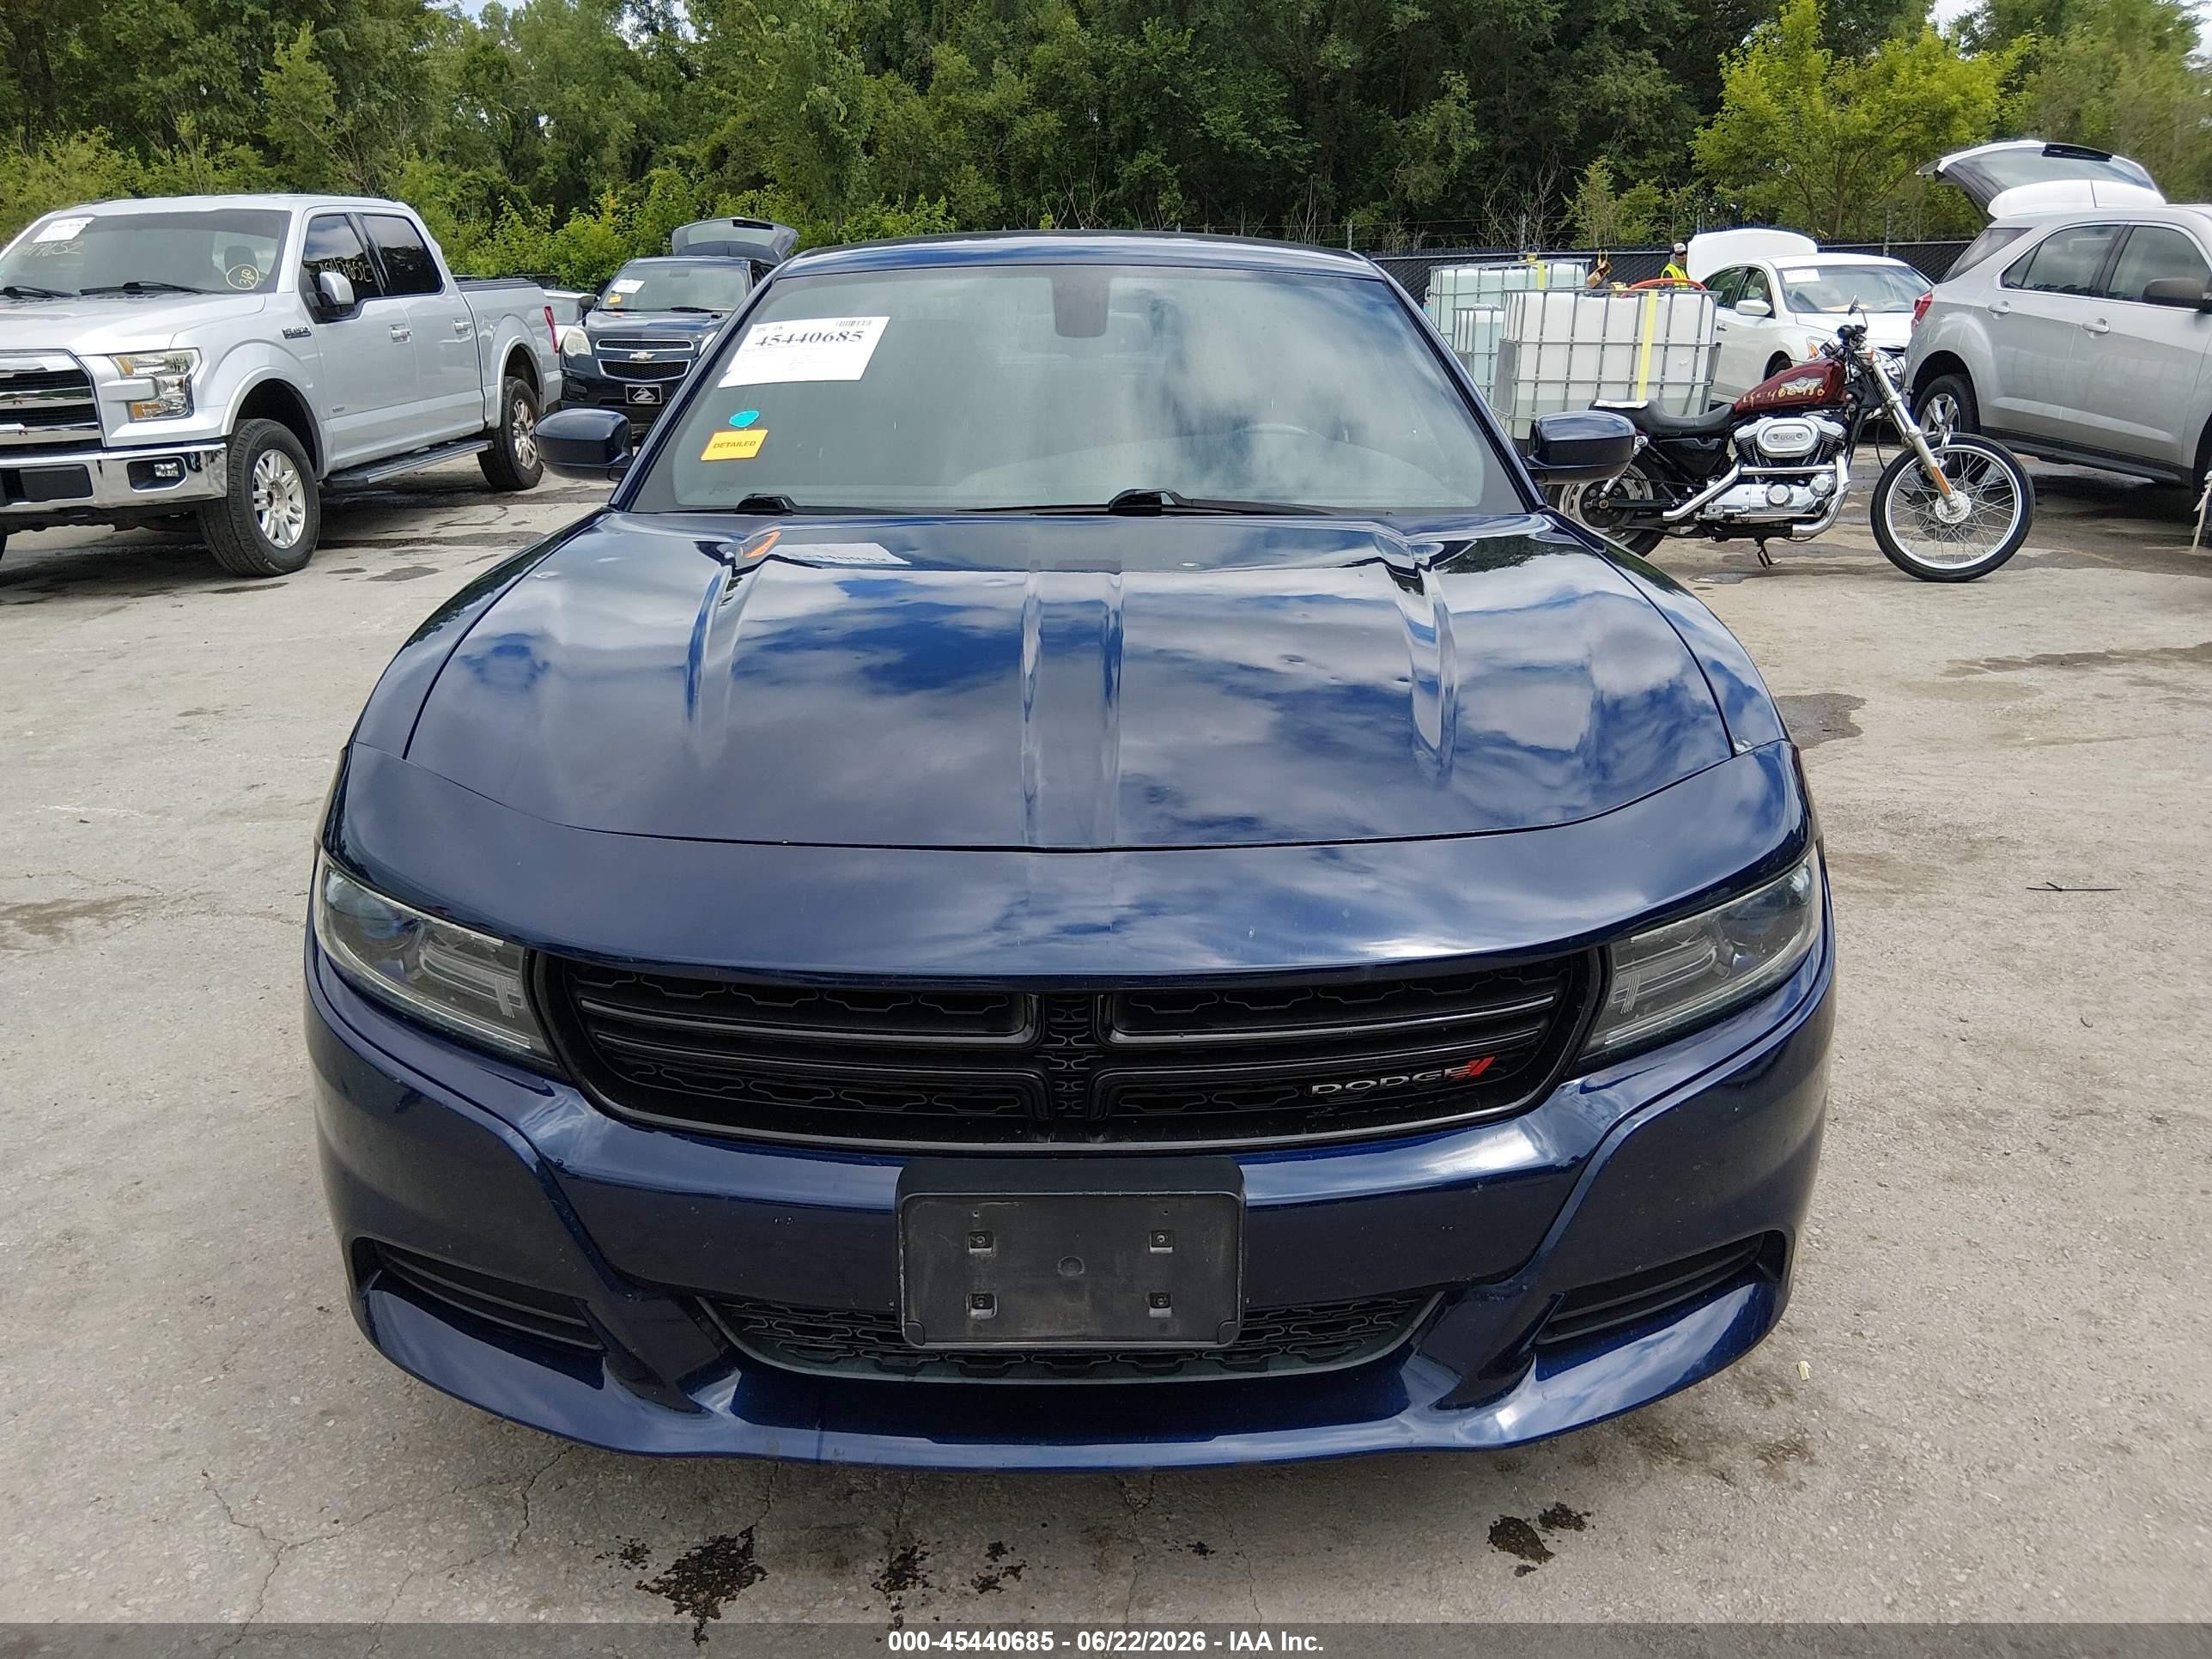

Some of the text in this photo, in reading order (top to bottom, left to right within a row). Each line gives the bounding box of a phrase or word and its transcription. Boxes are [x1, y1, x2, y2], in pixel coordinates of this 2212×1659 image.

[755, 331, 866, 347] 45440685
[713, 441, 757, 449] DETAILED
[1312, 1064, 1472, 1095] DODGE
